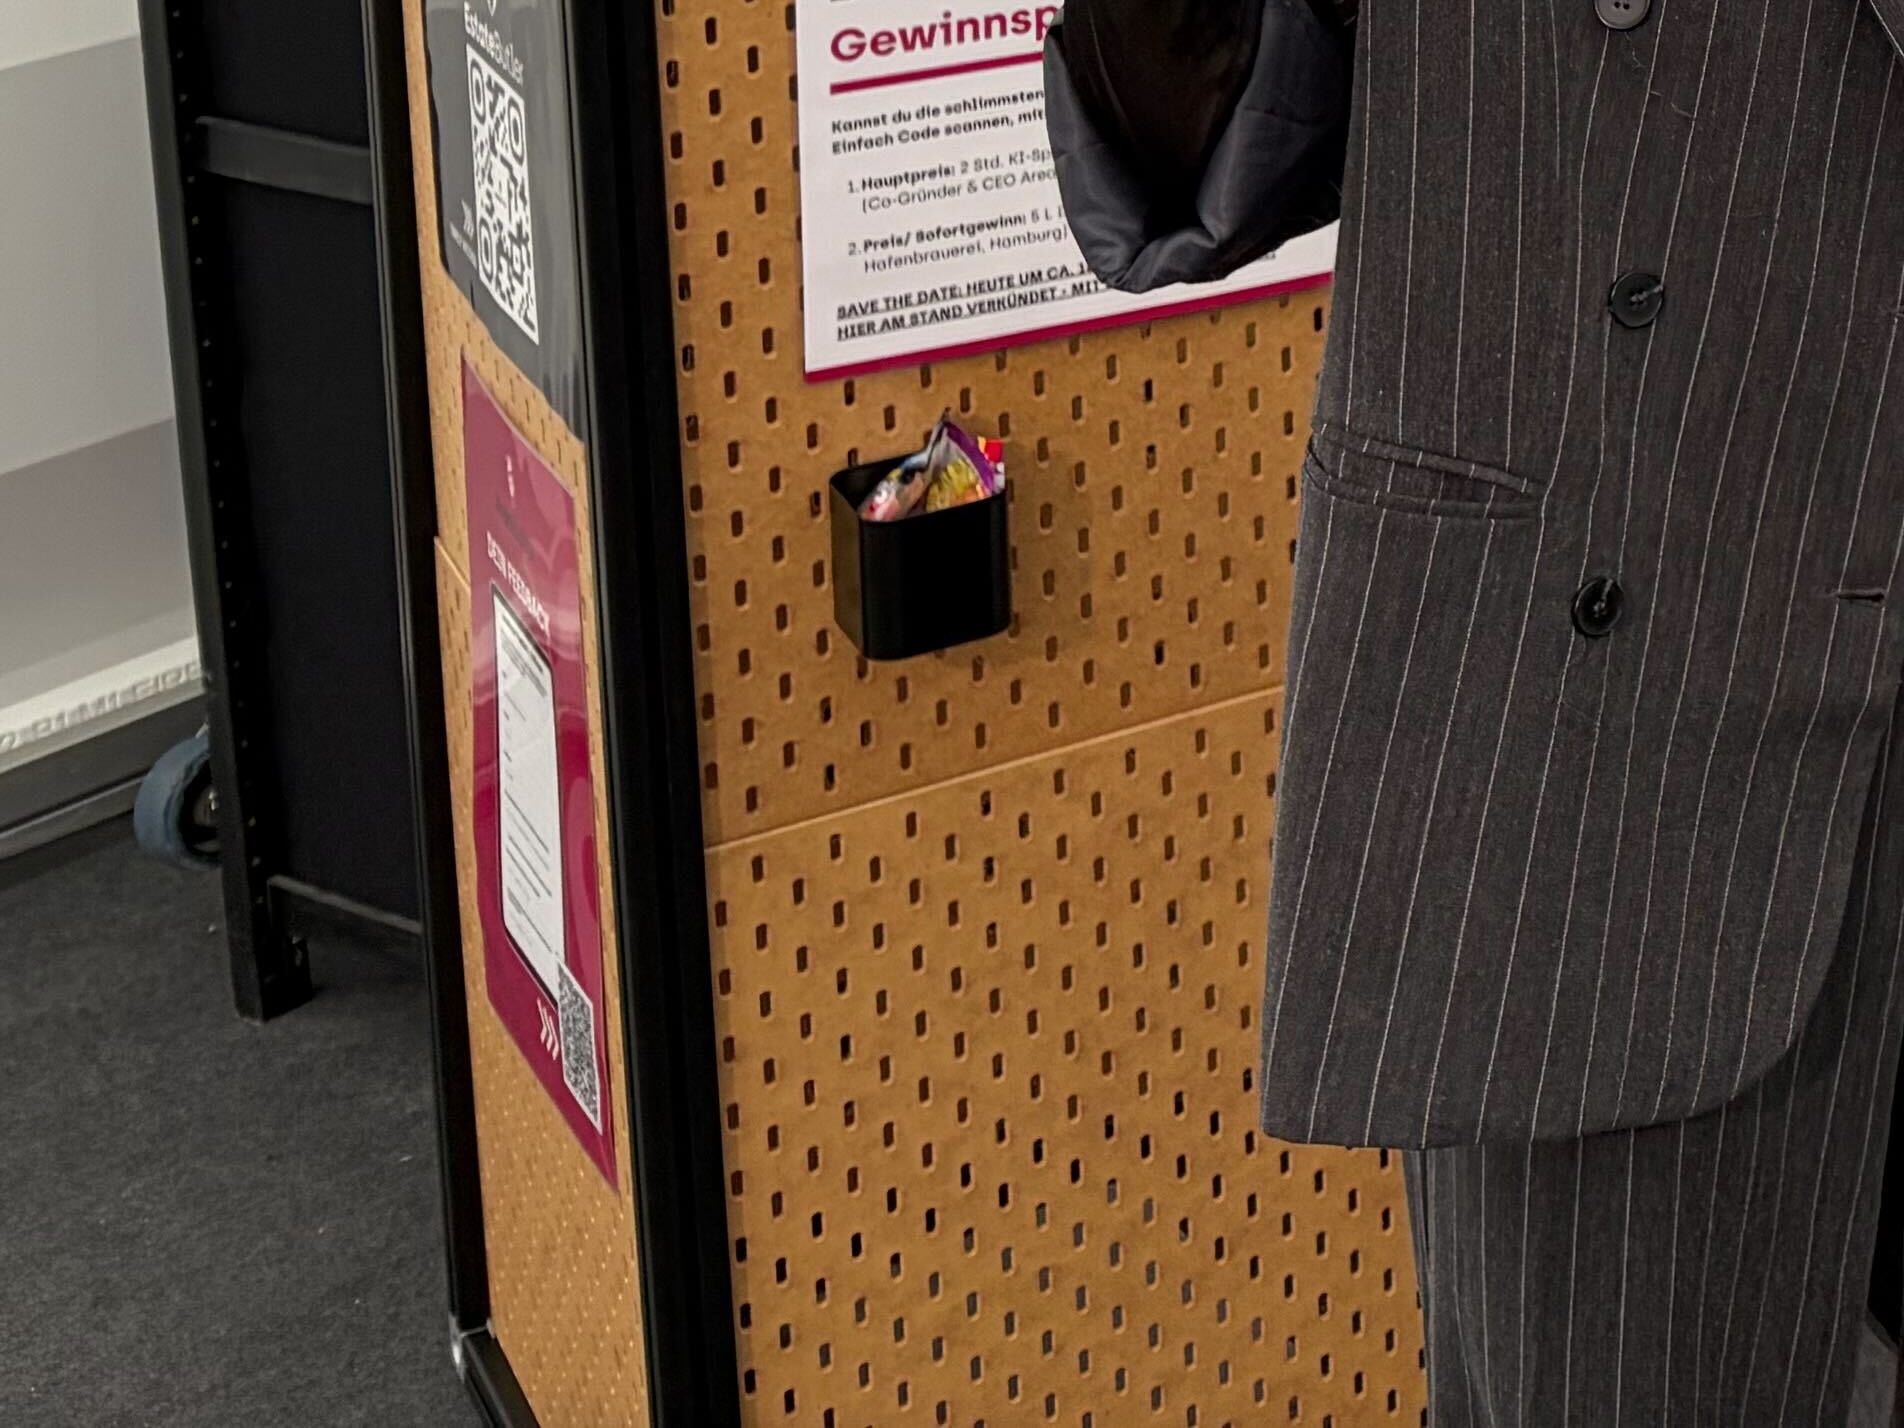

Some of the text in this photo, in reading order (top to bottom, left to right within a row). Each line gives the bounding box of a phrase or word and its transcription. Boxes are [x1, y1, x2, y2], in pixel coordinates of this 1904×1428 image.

[832, 90, 1045, 135] Kannst du die schlimmsten
[832, 108, 1044, 155] Einfach Code scannen, mit
[861, 163, 956, 192] Hauptpreis:
[967, 180, 978, 194] &
[983, 174, 1016, 191] CEO
[916, 214, 1027, 243] Sofortgewinn:
[837, 300, 885, 320] SAVE
[886, 293, 913, 311] THE
[917, 284, 963, 305] DATE:
[966, 276, 1015, 297] HEUTE
[1019, 270, 1044, 286] UM
[1047, 263, 1075, 280] CA.
[837, 322, 877, 342] HIER
[880, 315, 905, 333] AM
[910, 304, 963, 326] STAND
[967, 286, 1057, 316] VERKÜNDET
